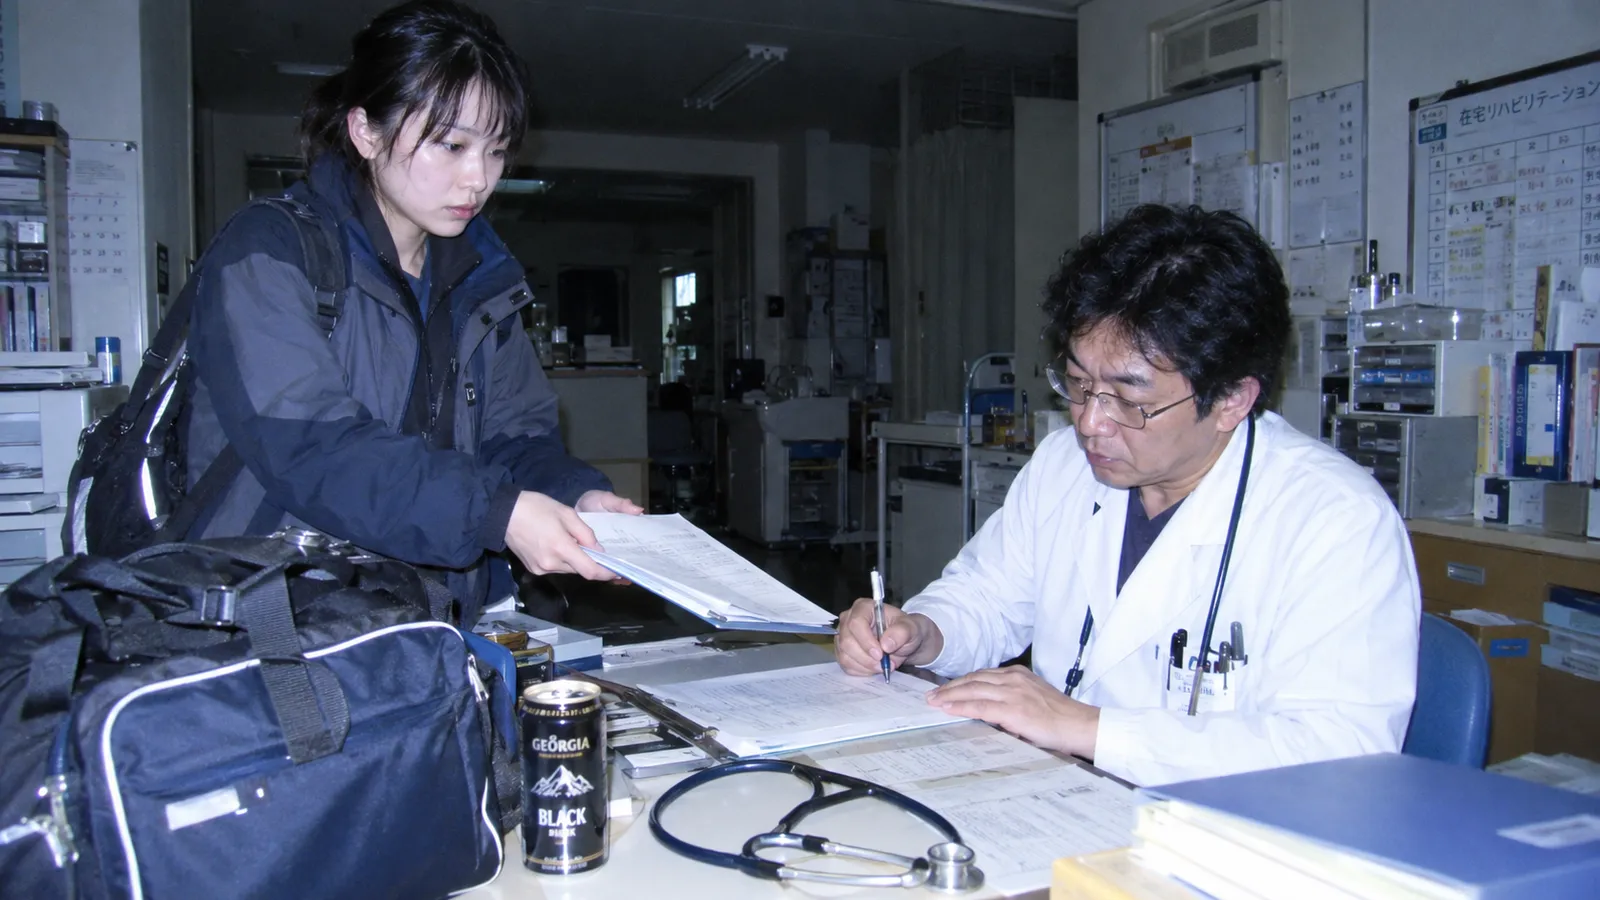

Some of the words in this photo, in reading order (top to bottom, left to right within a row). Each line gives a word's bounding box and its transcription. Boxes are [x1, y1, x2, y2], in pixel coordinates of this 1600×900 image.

[1459, 80, 1600, 126] 在宅リハビリテーション
[538, 806, 587, 827] BLACK
